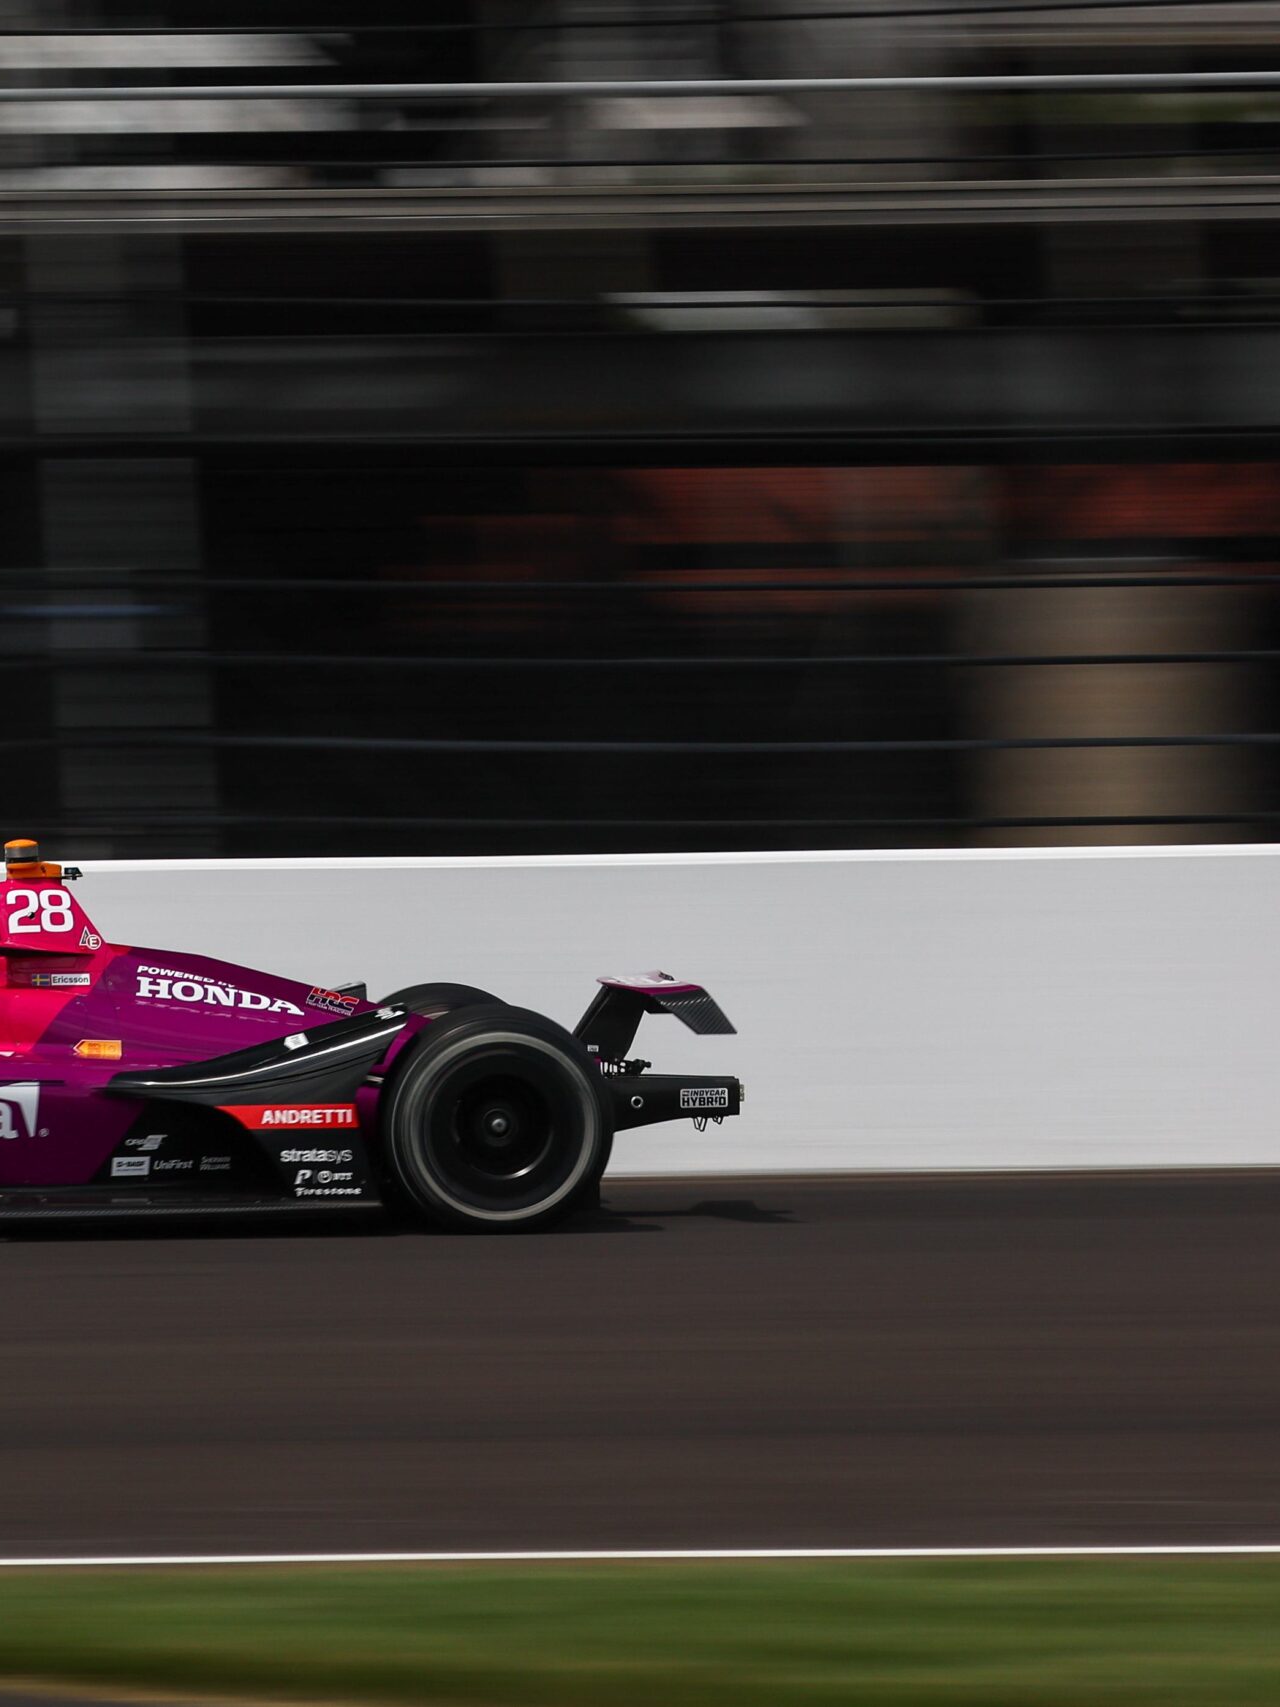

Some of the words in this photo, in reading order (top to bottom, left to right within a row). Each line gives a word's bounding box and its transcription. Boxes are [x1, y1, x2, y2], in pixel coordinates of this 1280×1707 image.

[6, 889, 74, 934] 28
[52, 975, 89, 984] Ericsson
[136, 965, 216, 983] POWERED
[135, 976, 305, 1016] HONDA
[690, 1089, 726, 1097] INDYCAR
[681, 1096, 726, 1107] HYBRID
[261, 1109, 353, 1125] ANDRETTI
[280, 1148, 353, 1164] stratasys
[153, 1159, 194, 1170] UniFirst
[294, 1187, 363, 1197] Firestone
